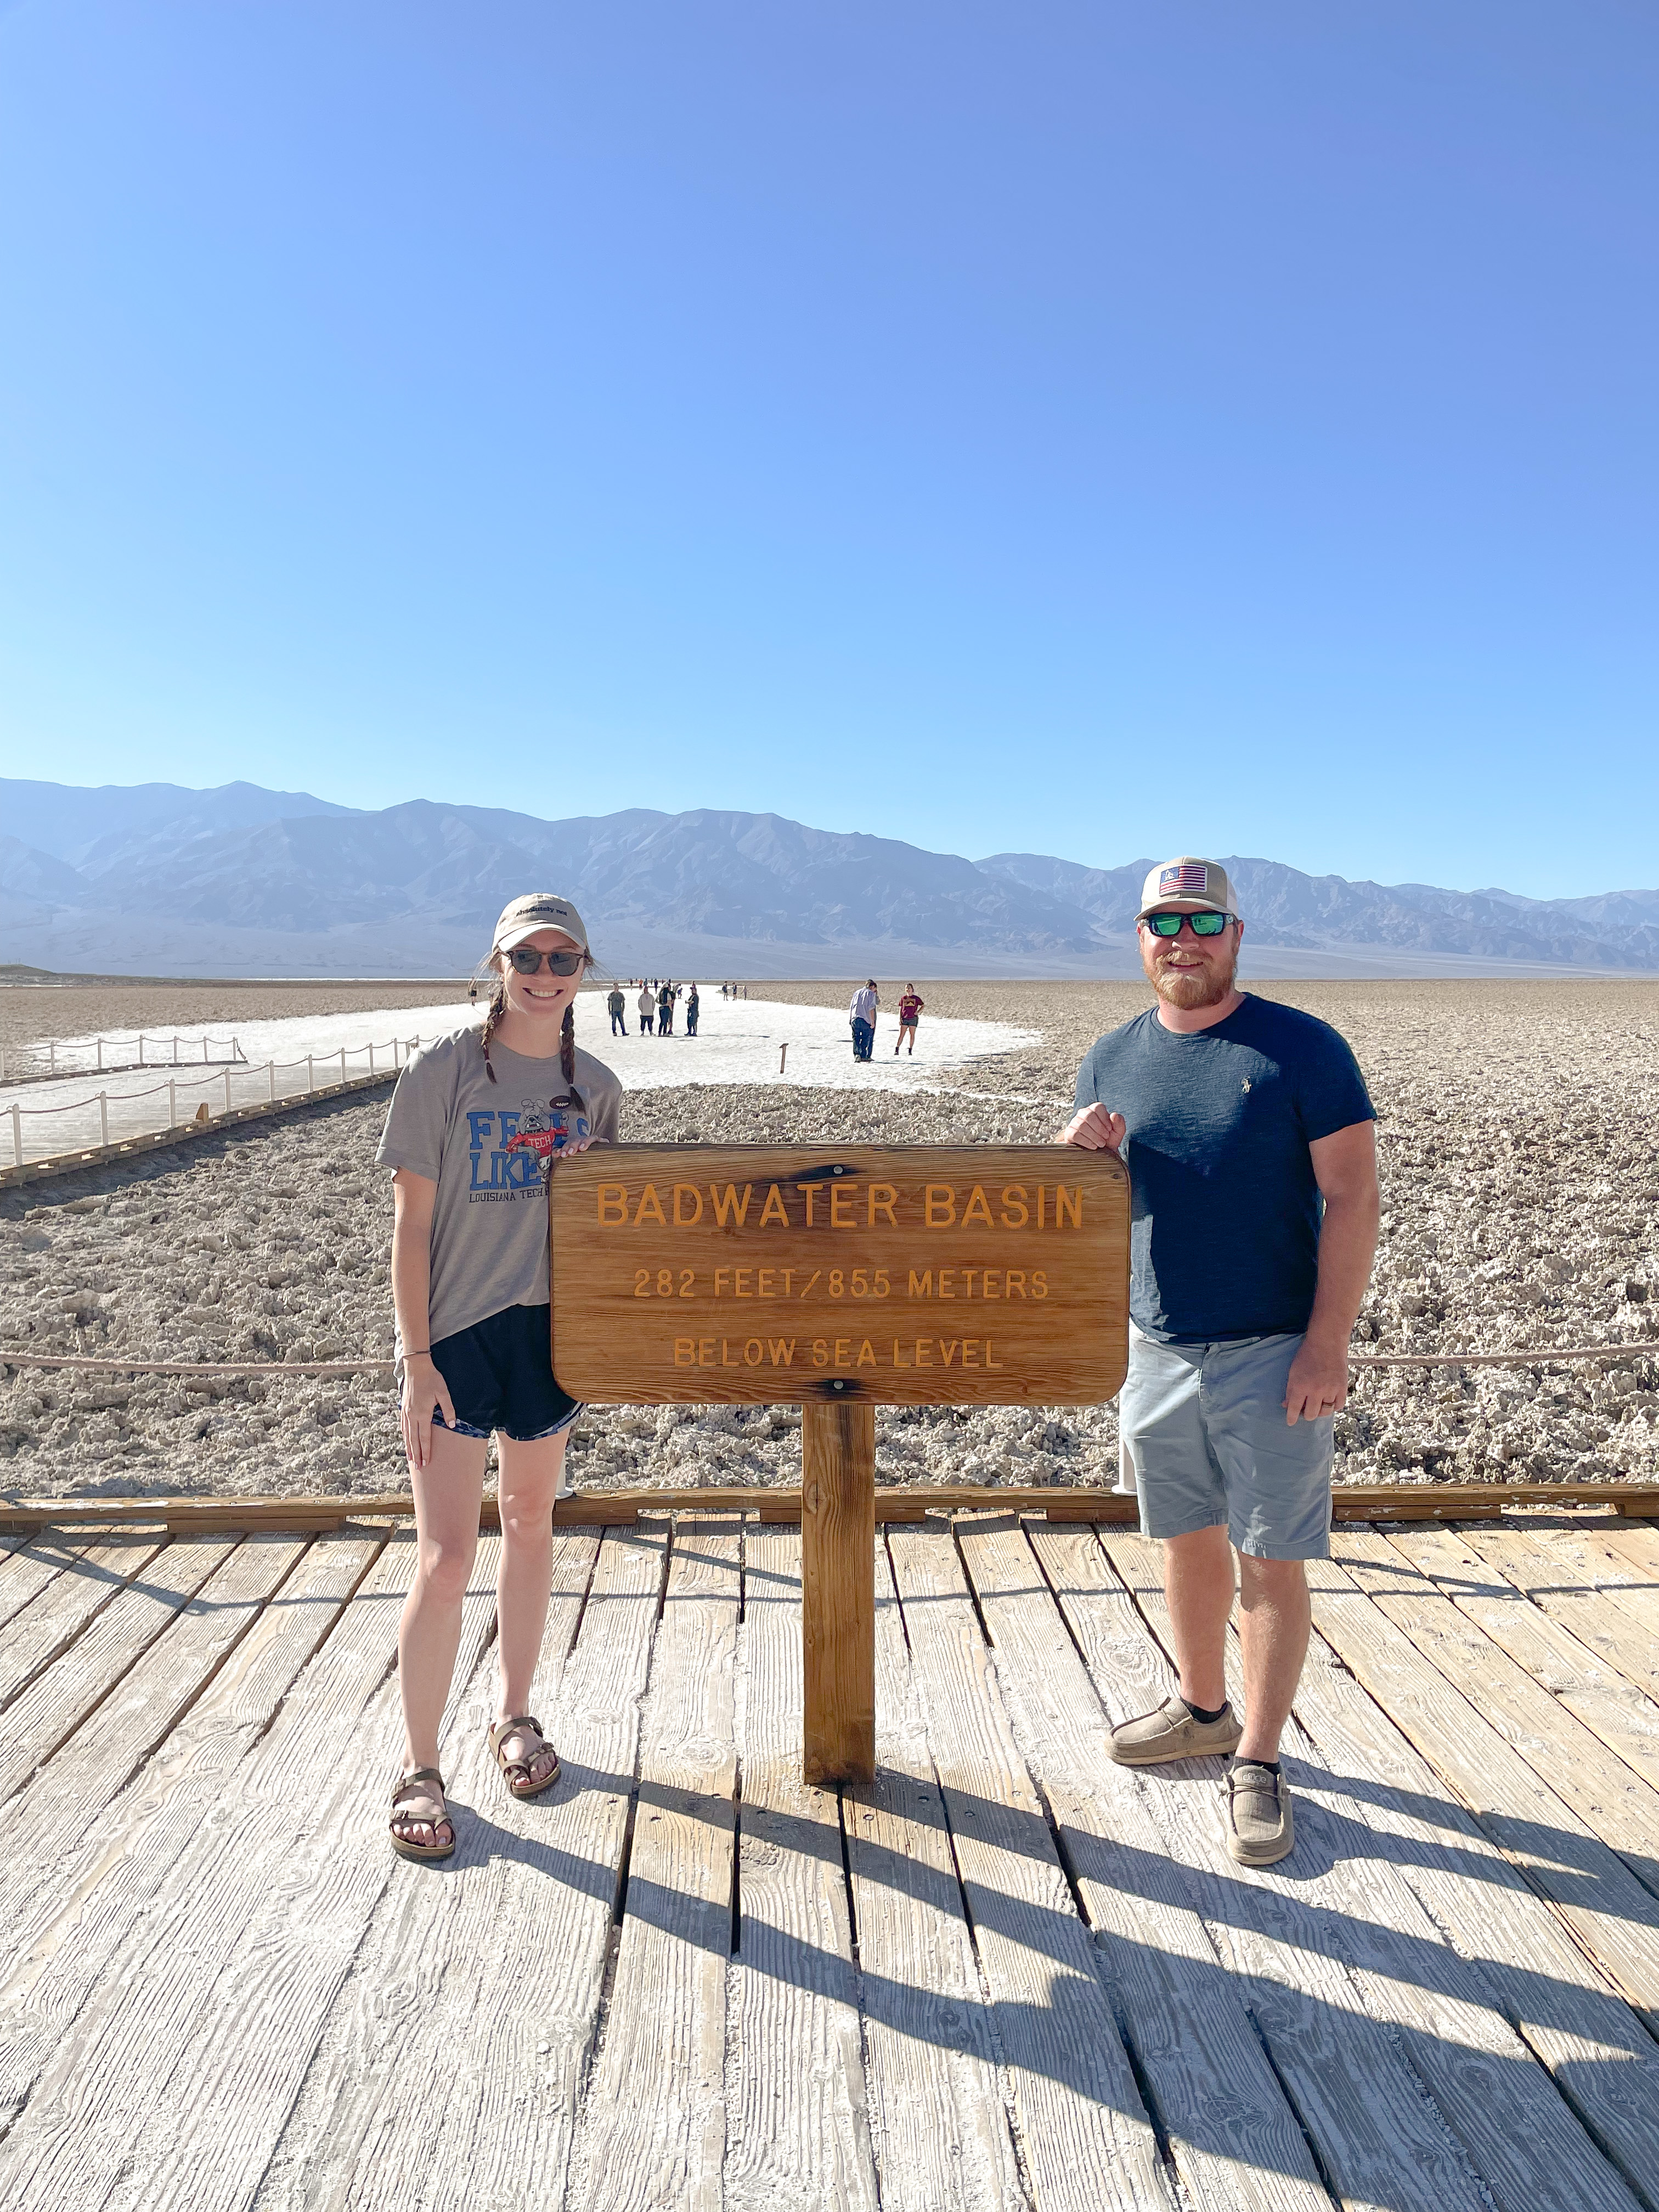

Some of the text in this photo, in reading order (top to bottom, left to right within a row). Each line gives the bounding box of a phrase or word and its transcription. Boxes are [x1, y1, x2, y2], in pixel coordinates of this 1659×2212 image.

[528, 1135, 552, 1149] TECH
[469, 1152, 541, 1190] LIKE
[469, 1192, 516, 1203] LOUISIANA
[519, 1187, 543, 1199] TECH
[597, 1183, 1083, 1229] BADWATER BASIN
[634, 1268, 1049, 1299] 282 FEET/855 METERS
[674, 1338, 1003, 1368] BELOW SEA LEVEL
